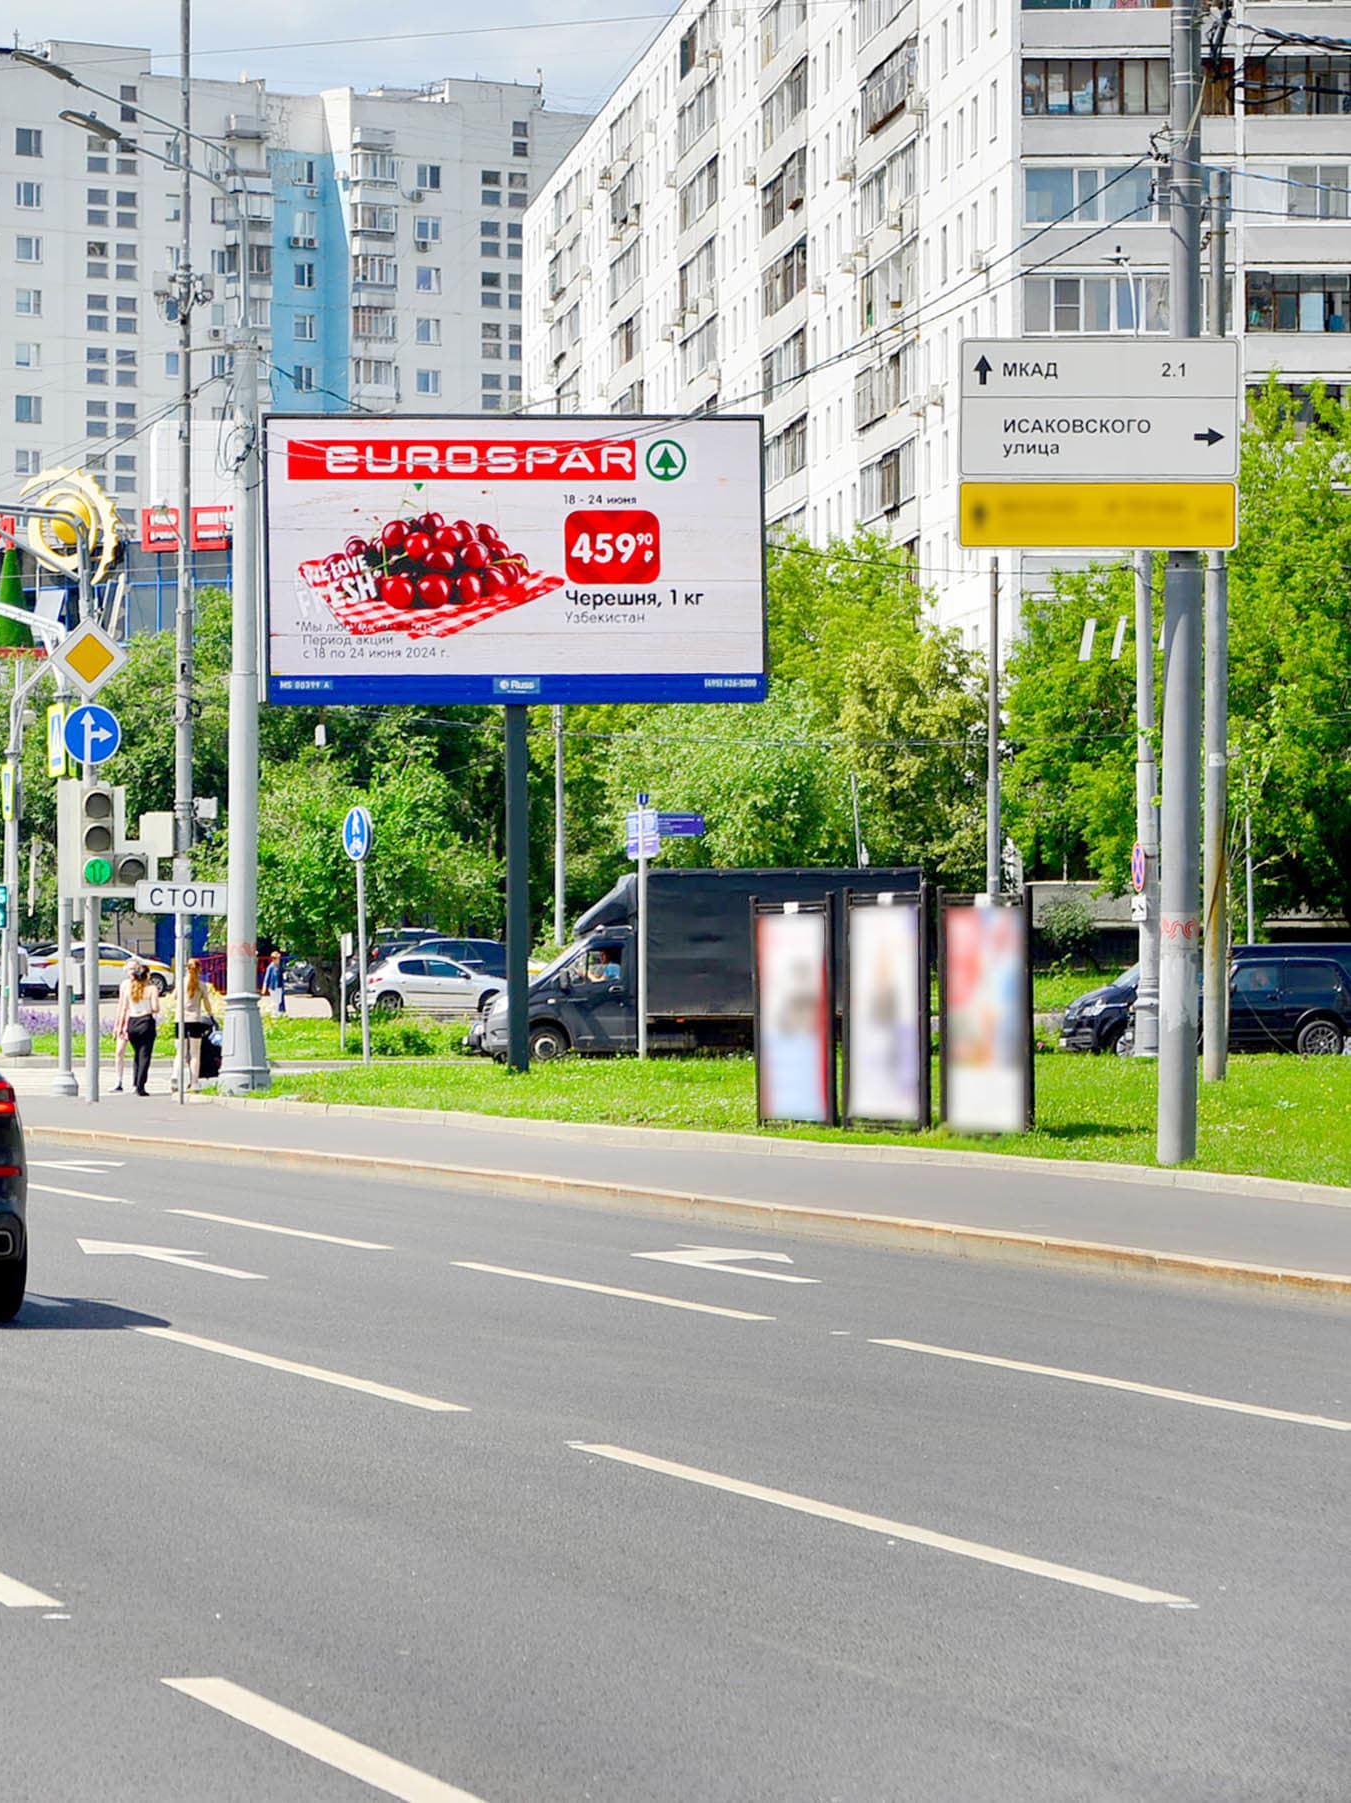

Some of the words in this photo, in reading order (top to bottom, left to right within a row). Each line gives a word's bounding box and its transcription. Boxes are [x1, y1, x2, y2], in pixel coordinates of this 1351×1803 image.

[1002, 362, 1059, 379] МКАД
[1161, 362, 1186, 377] 2.1
[1003, 418, 1151, 434] ИСАКОВСКОГО
[1003, 443, 1060, 458] улица
[325, 444, 633, 474] EUROSPAR
[563, 494, 576, 505] 18
[587, 494, 603, 505] 24
[606, 496, 637, 505] июня
[330, 554, 368, 581] LOVE
[565, 589, 663, 610] Черешня,
[669, 589, 678, 606] 1
[684, 592, 704, 606] кг
[565, 611, 646, 624] Узбекистан
[302, 635, 351, 647] Период
[355, 637, 394, 648] акции
[303, 650, 310, 659] с
[314, 648, 326, 659] 18
[330, 650, 346, 659] по
[350, 647, 364, 658] 24
[369, 649, 401, 658] июня
[405, 647, 437, 658] 2024
[150, 887, 215, 909] СТОП
